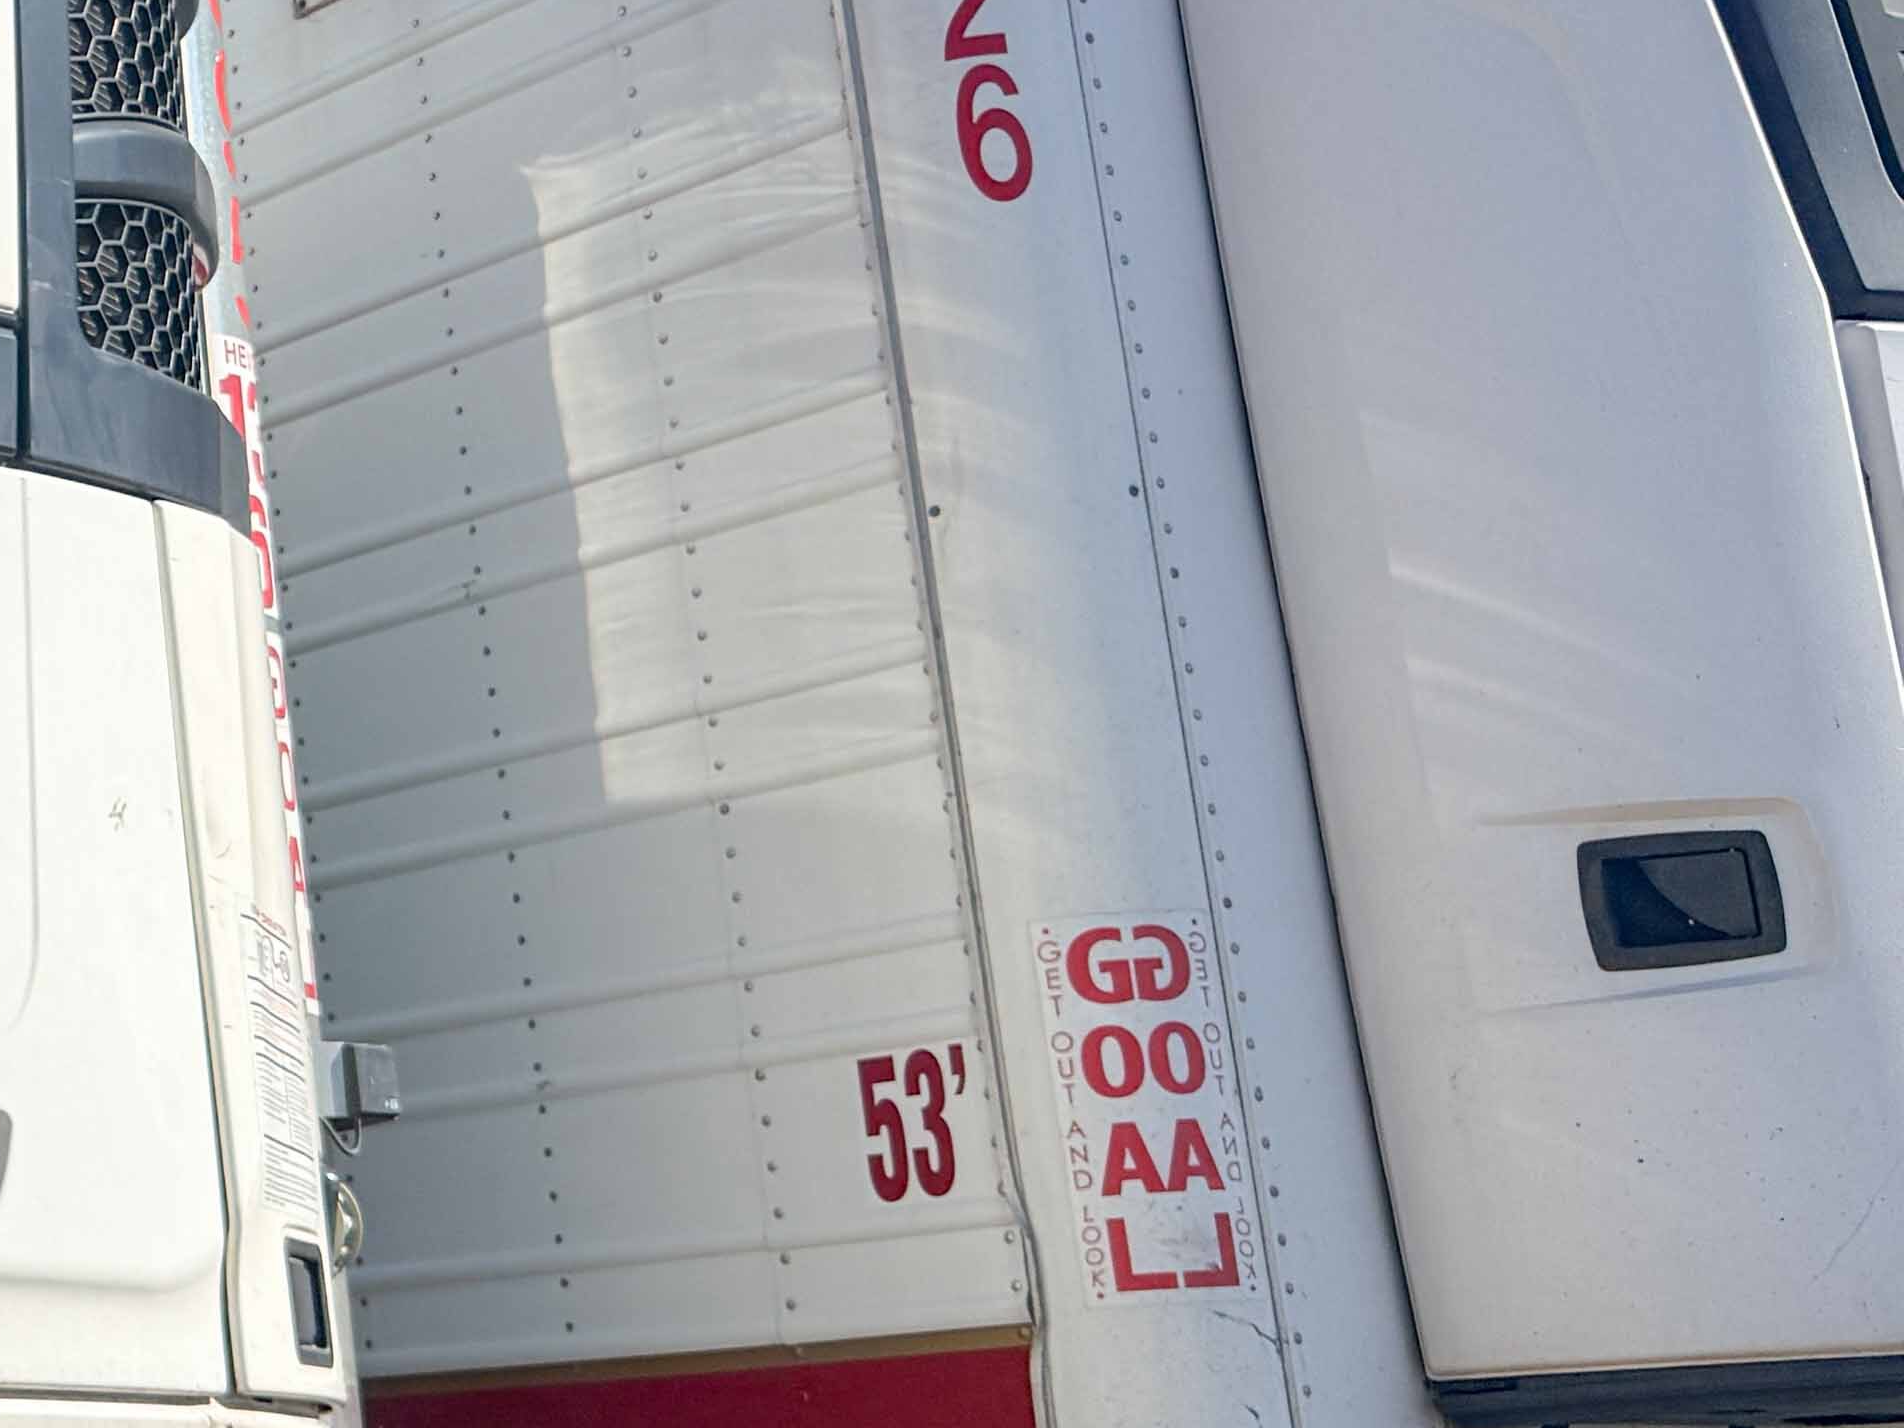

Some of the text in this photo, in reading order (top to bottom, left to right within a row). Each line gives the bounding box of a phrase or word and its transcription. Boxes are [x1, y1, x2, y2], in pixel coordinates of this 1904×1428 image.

[857, 1043, 966, 1203] 53'
[1036, 939, 1106, 1287] GET OUT AND LOOK
[1065, 926, 1180, 1292] GOAL
